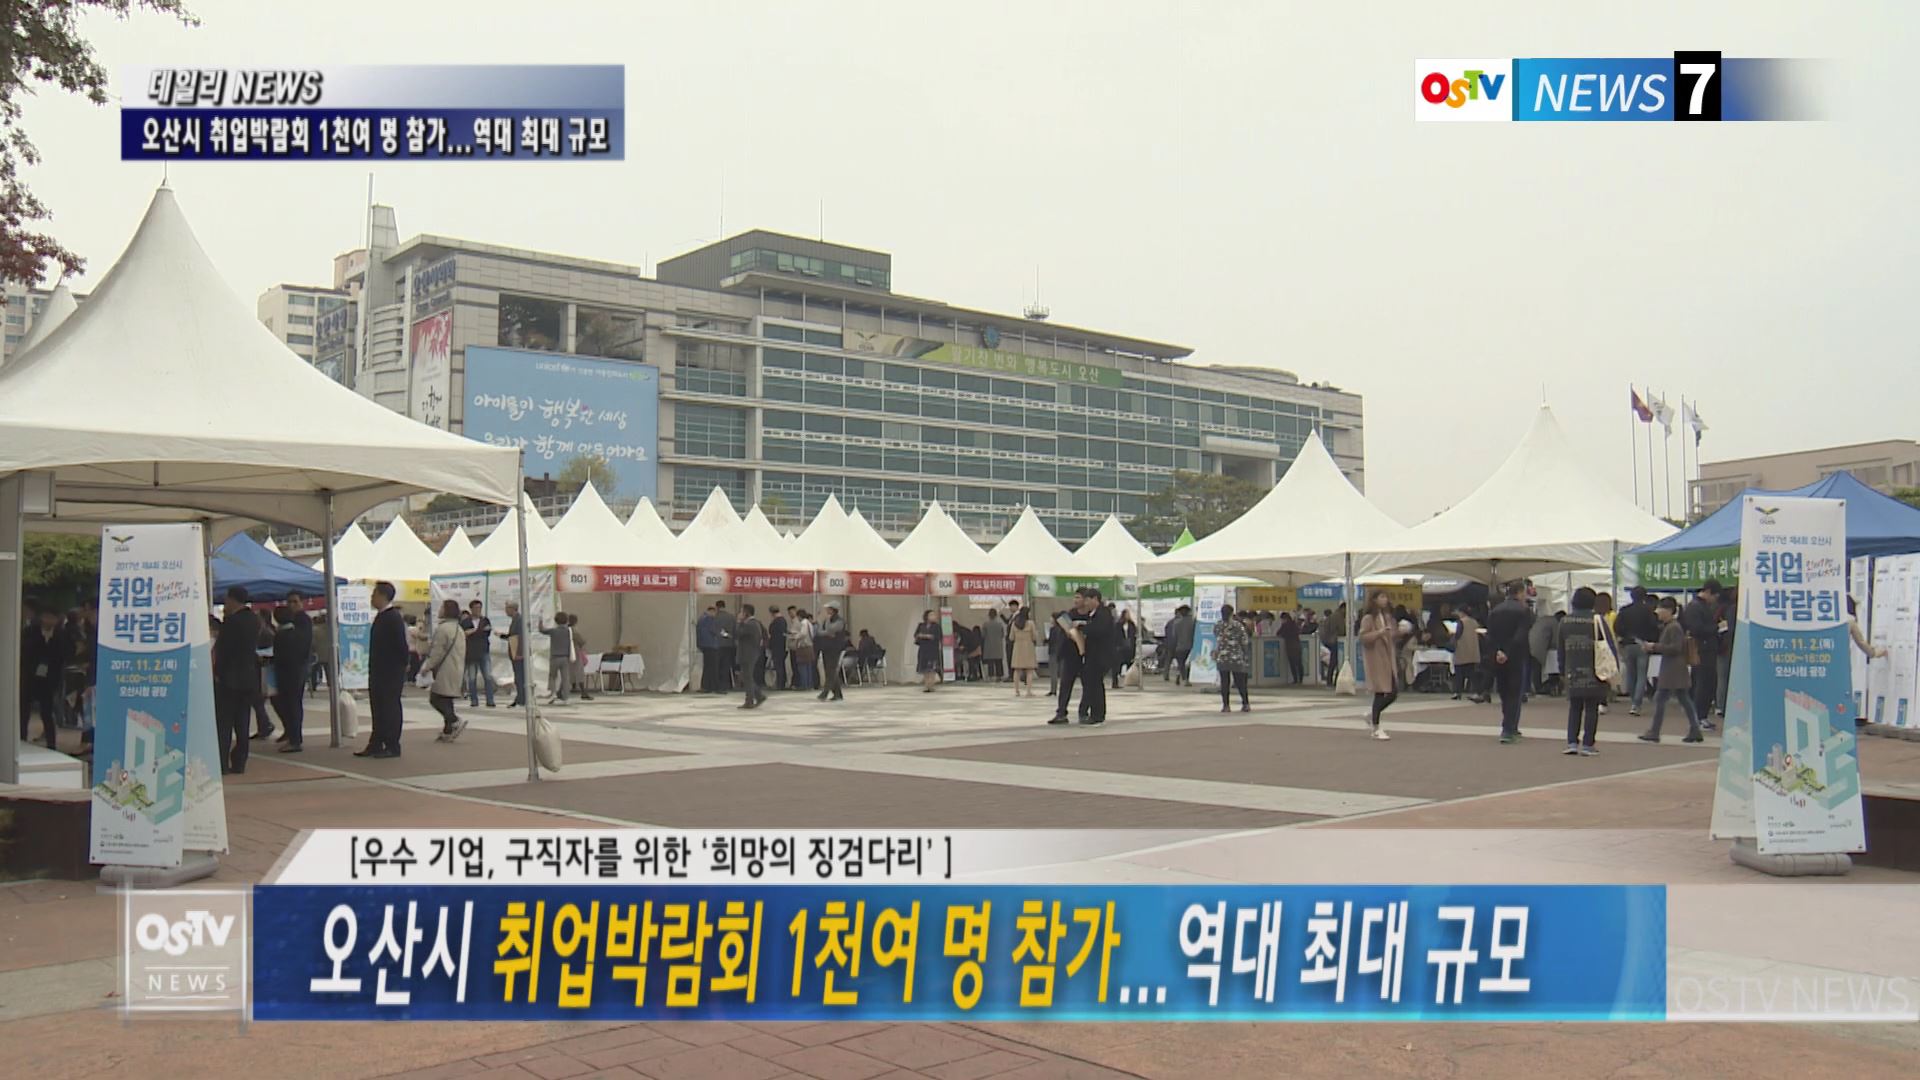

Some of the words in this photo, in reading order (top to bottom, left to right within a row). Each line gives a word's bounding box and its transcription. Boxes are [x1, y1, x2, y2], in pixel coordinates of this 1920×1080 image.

[1025, 356, 1072, 379] 행복도시
[1079, 366, 1100, 383] 오산
[474, 394, 533, 421] 아이들이
[538, 397, 594, 429] 행복한
[598, 409, 627, 430] 세상
[532, 433, 573, 460] 함께
[1762, 535, 1787, 544] 2017년
[1811, 535, 1832, 545] 오산시
[116, 561, 140, 570] 2017년
[162, 560, 183, 569] 오산시
[1756, 552, 1802, 583] 취업
[603, 574, 640, 587] 기업지원
[642, 574, 678, 587] 프로그램
[939, 580, 952, 589] B04
[107, 576, 152, 608] 취업
[1765, 590, 1840, 622] 박람회
[114, 612, 186, 643] 박람회
[1764, 638, 1788, 649] 2017.
[1792, 638, 1807, 650] 11.
[111, 659, 132, 671] 2017.
[136, 659, 151, 671] 11.
[1809, 666, 1826, 677] 광장
